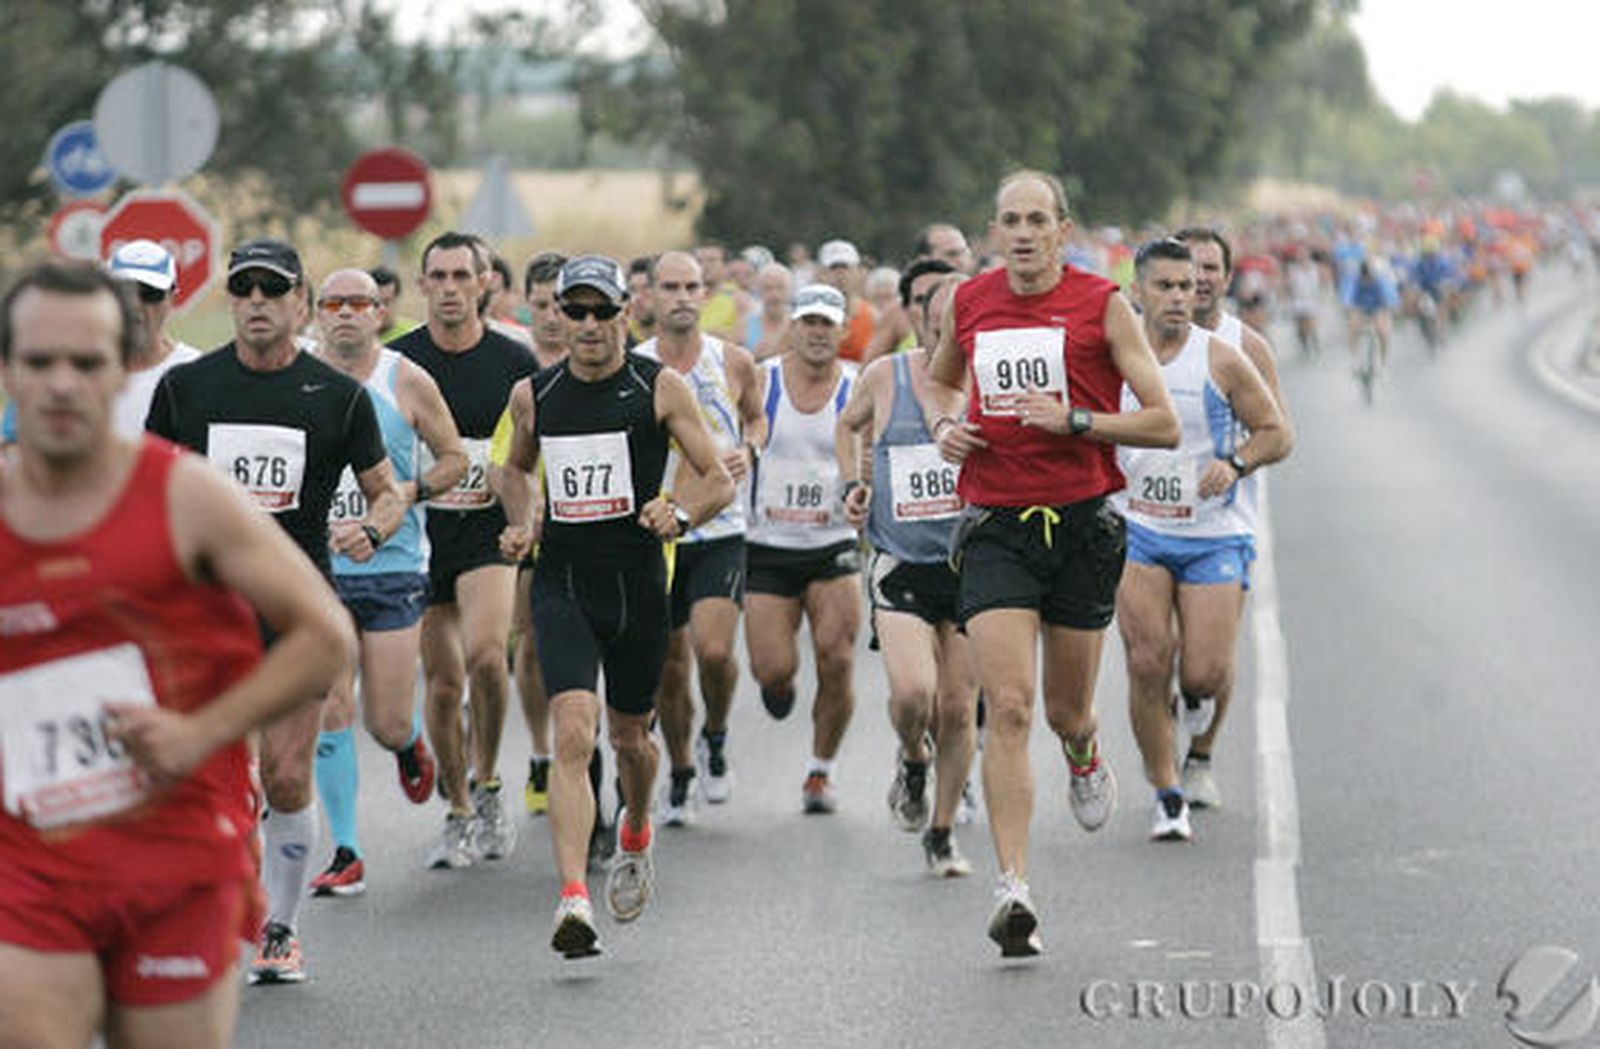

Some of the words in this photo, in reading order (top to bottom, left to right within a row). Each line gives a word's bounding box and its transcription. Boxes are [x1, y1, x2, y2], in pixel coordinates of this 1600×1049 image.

[996, 356, 1049, 390] 900
[233, 456, 287, 488] 676
[562, 464, 613, 498] 677
[909, 467, 956, 499] 986
[785, 482, 823, 507] 186
[1141, 475, 1182, 503] 206
